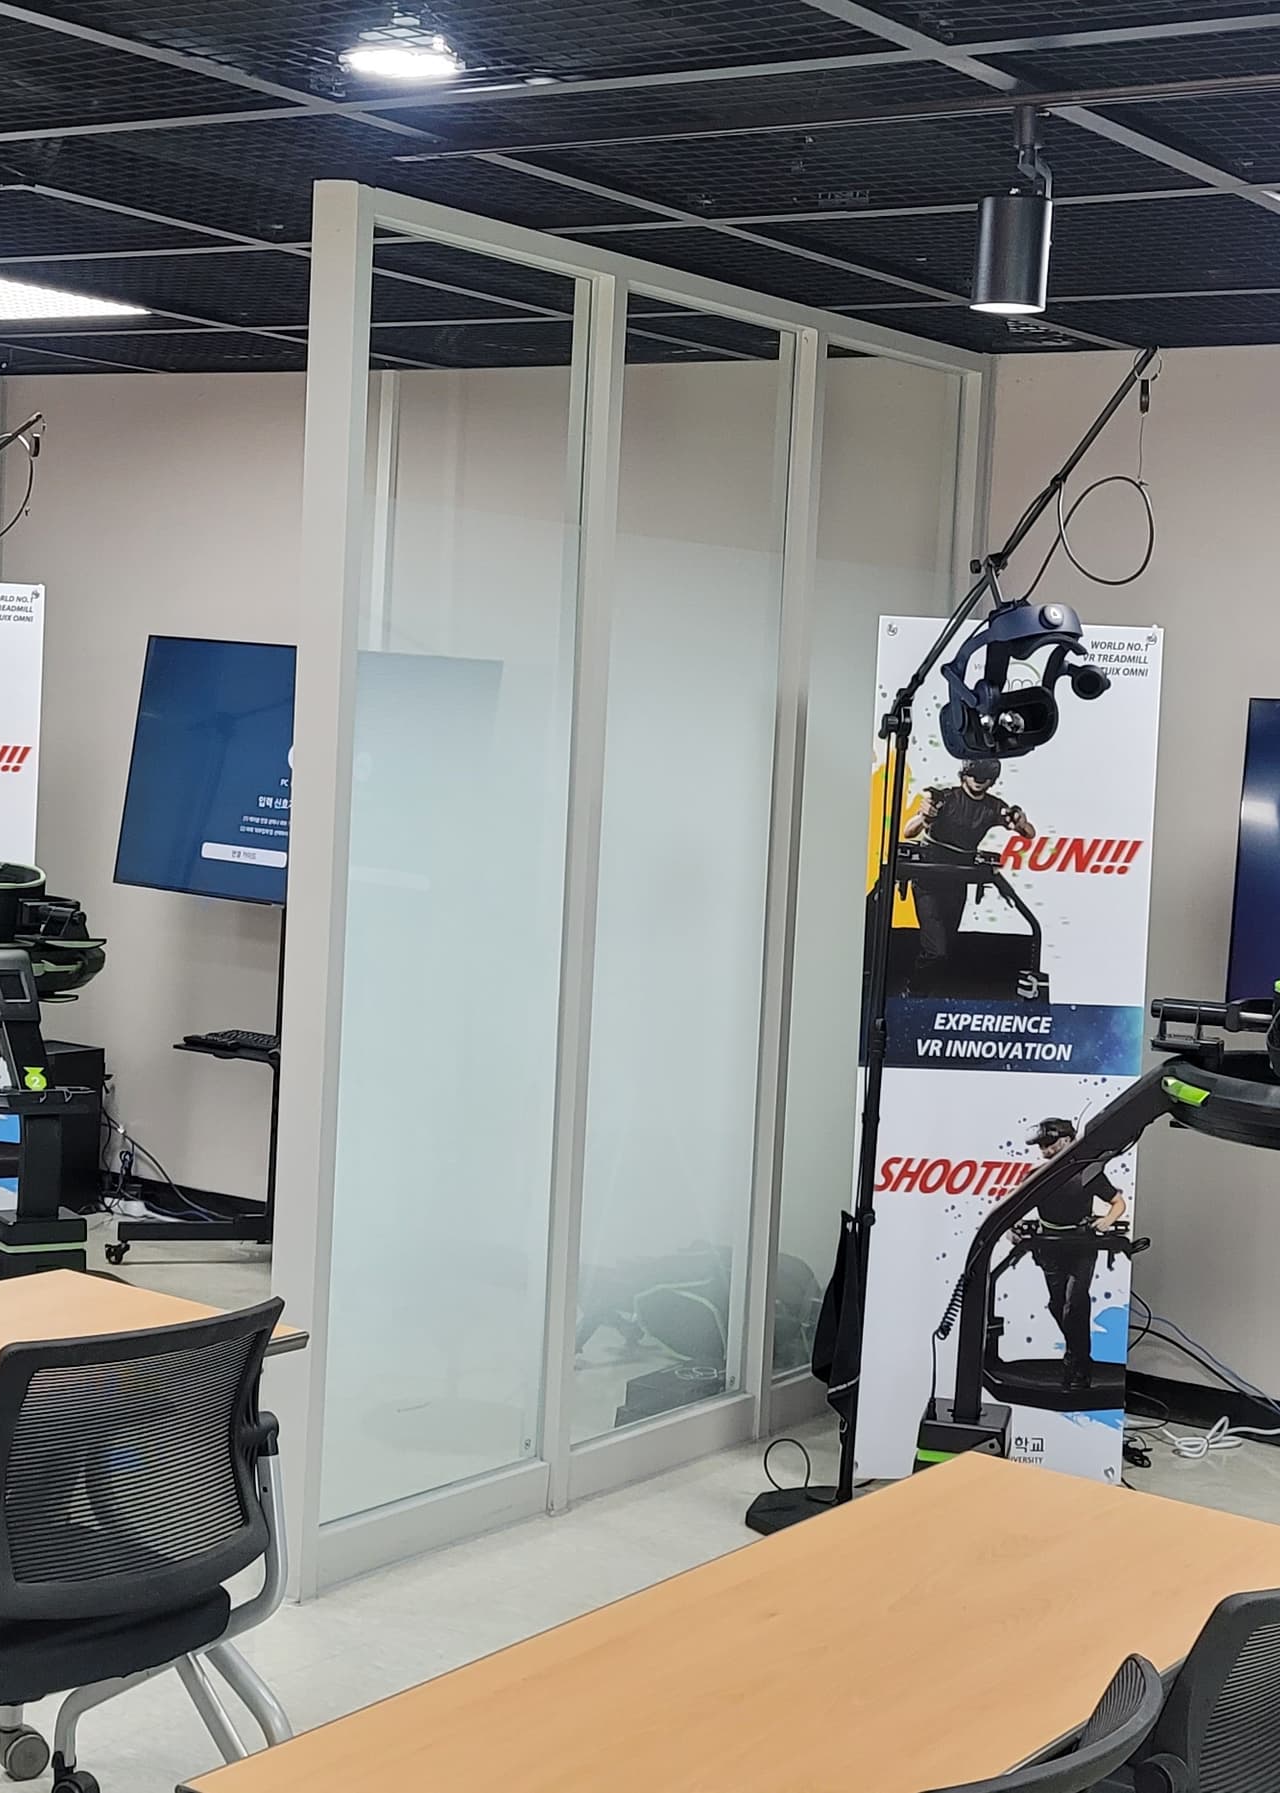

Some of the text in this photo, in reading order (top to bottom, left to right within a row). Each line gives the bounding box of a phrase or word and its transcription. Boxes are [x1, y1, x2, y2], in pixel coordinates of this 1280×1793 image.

[1090, 640, 1149, 652] WORLD NO.1
[1097, 653, 1149, 665] TREADMILL
[1122, 667, 1149, 677] OMNI
[1000, 835, 1144, 875] RUN!!!
[933, 1012, 1053, 1034] EXPERIENCE
[916, 1038, 1073, 1062] VR INNOVATION
[30, 1076, 41, 1088] 2
